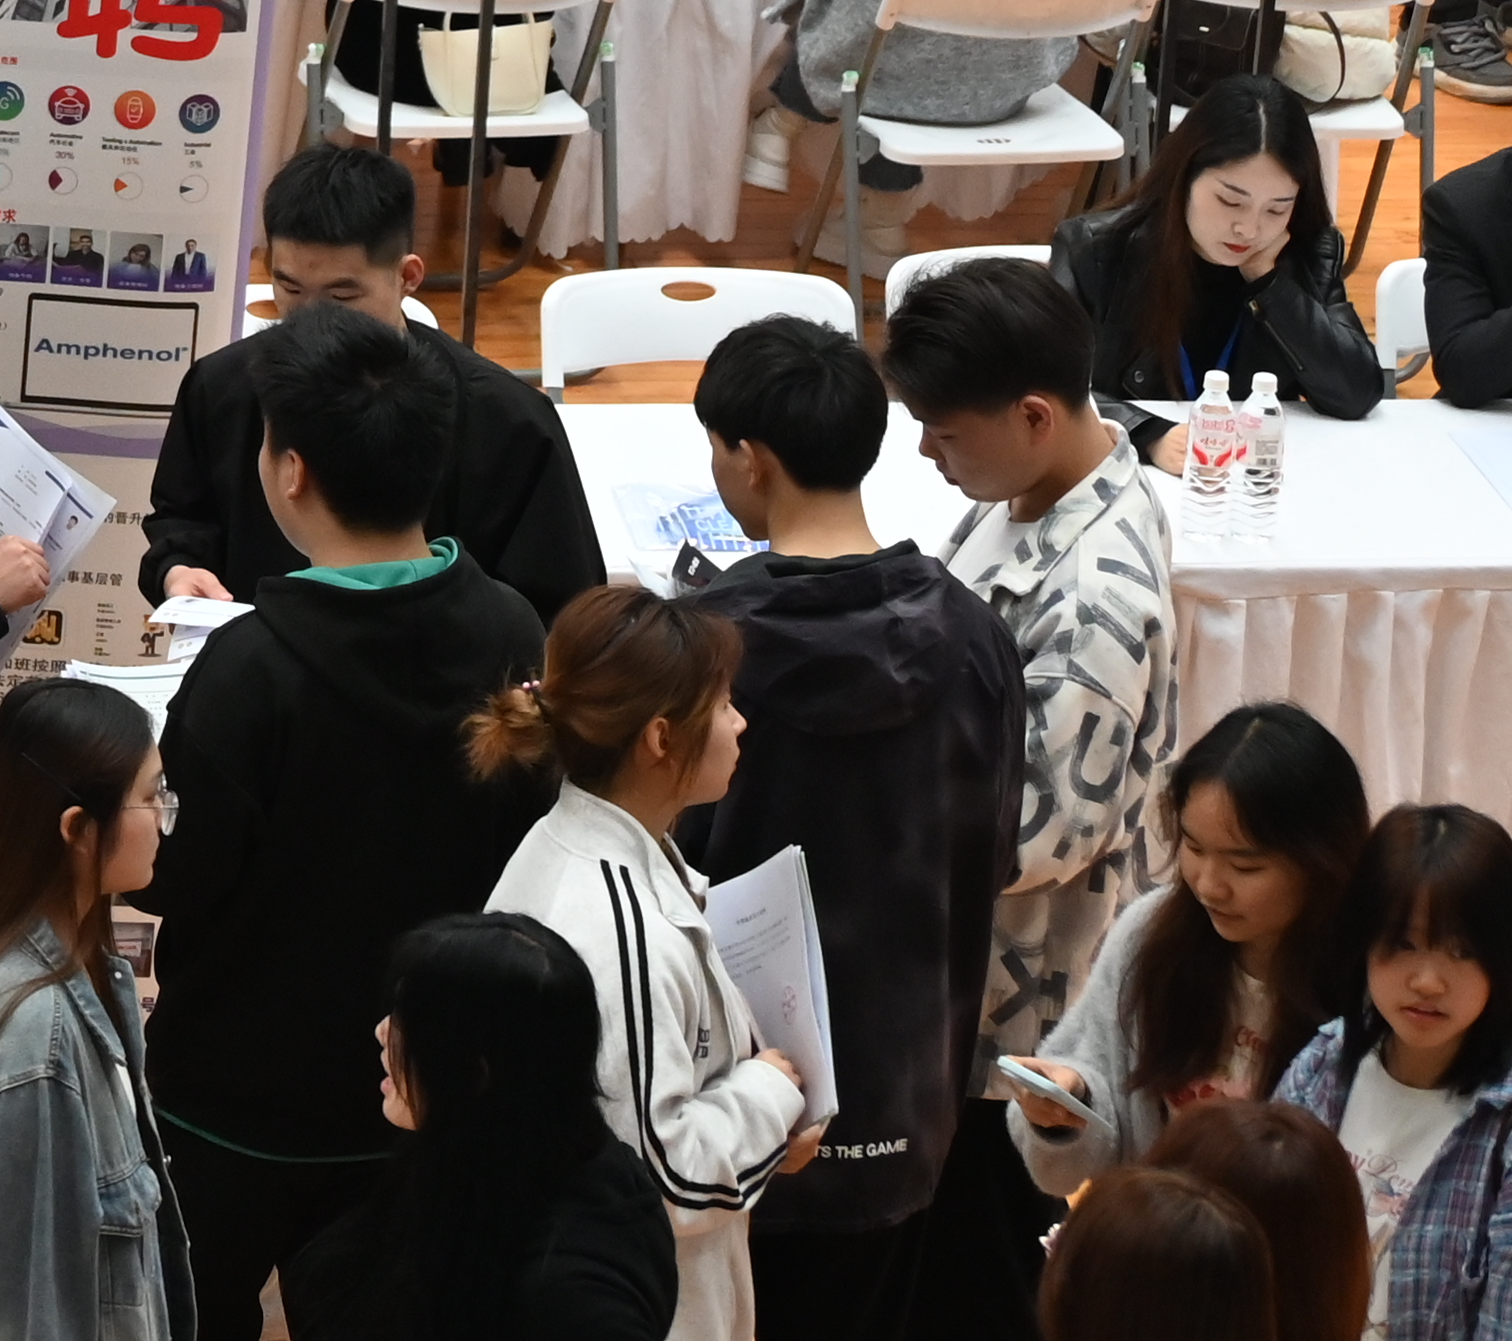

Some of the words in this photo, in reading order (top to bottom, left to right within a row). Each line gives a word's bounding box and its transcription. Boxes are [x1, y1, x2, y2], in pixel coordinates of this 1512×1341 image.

[34, 336, 183, 363] Amphenol
[835, 1145, 864, 1159] THE
[865, 1138, 909, 1157] GAME
